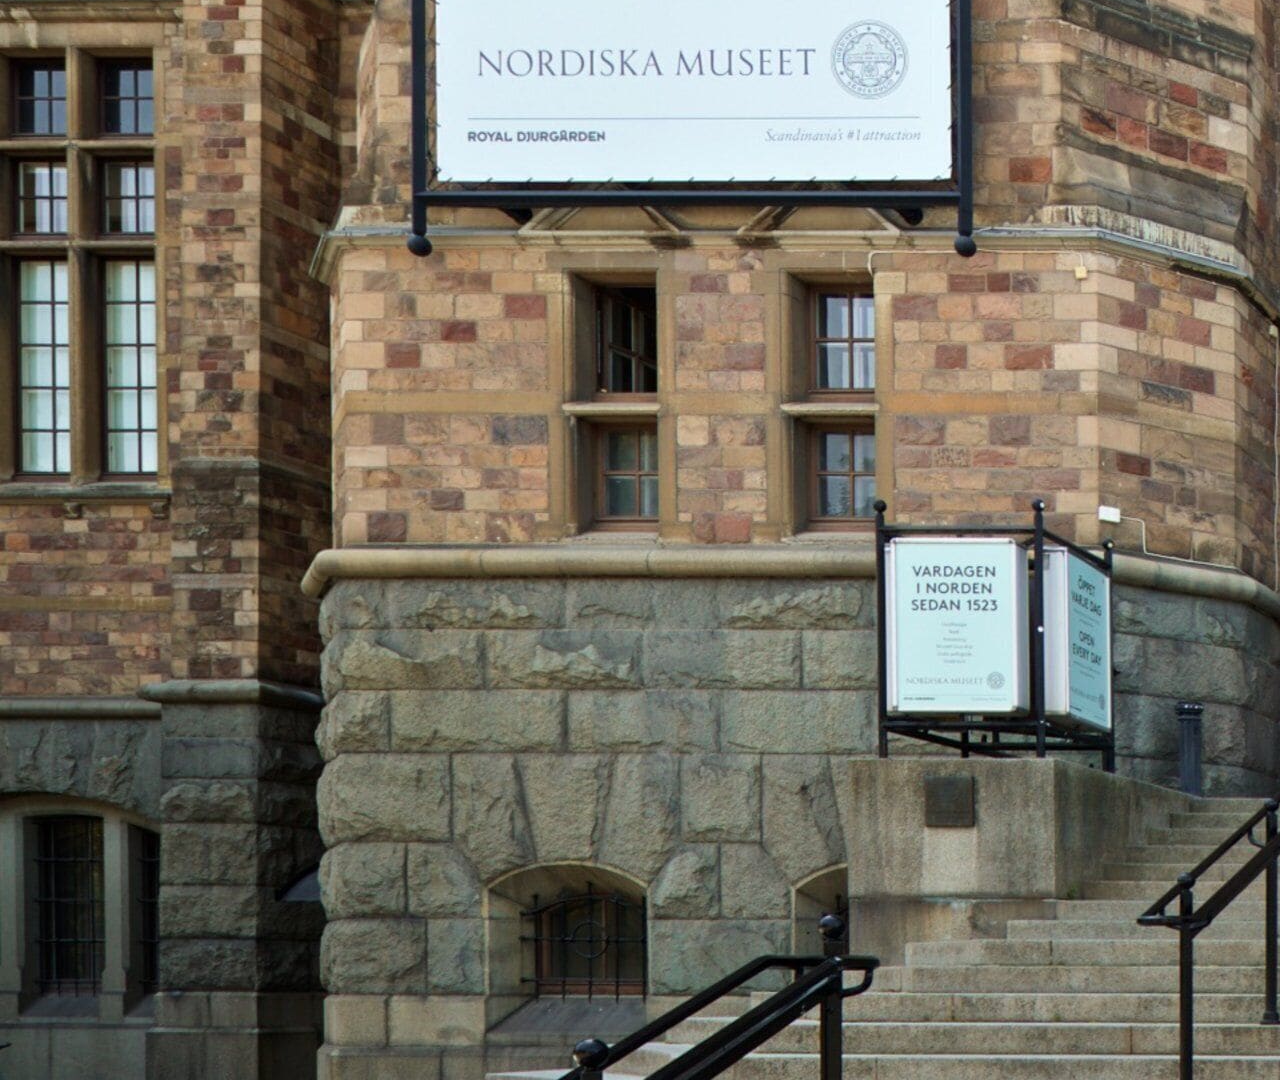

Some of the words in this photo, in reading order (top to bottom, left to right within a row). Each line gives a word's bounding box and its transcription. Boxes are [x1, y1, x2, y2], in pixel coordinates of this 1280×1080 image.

[478, 49, 663, 77] NORDISKA
[676, 48, 817, 77] MUSEET
[467, 131, 513, 143] ROYAL
[516, 129, 606, 143] DJURGÅRDEN
[912, 565, 996, 578] VARDAGEN
[916, 582, 921, 594] I
[926, 582, 992, 595] NORDEN
[911, 598, 961, 612] SEDAN
[966, 599, 998, 612] 1523
